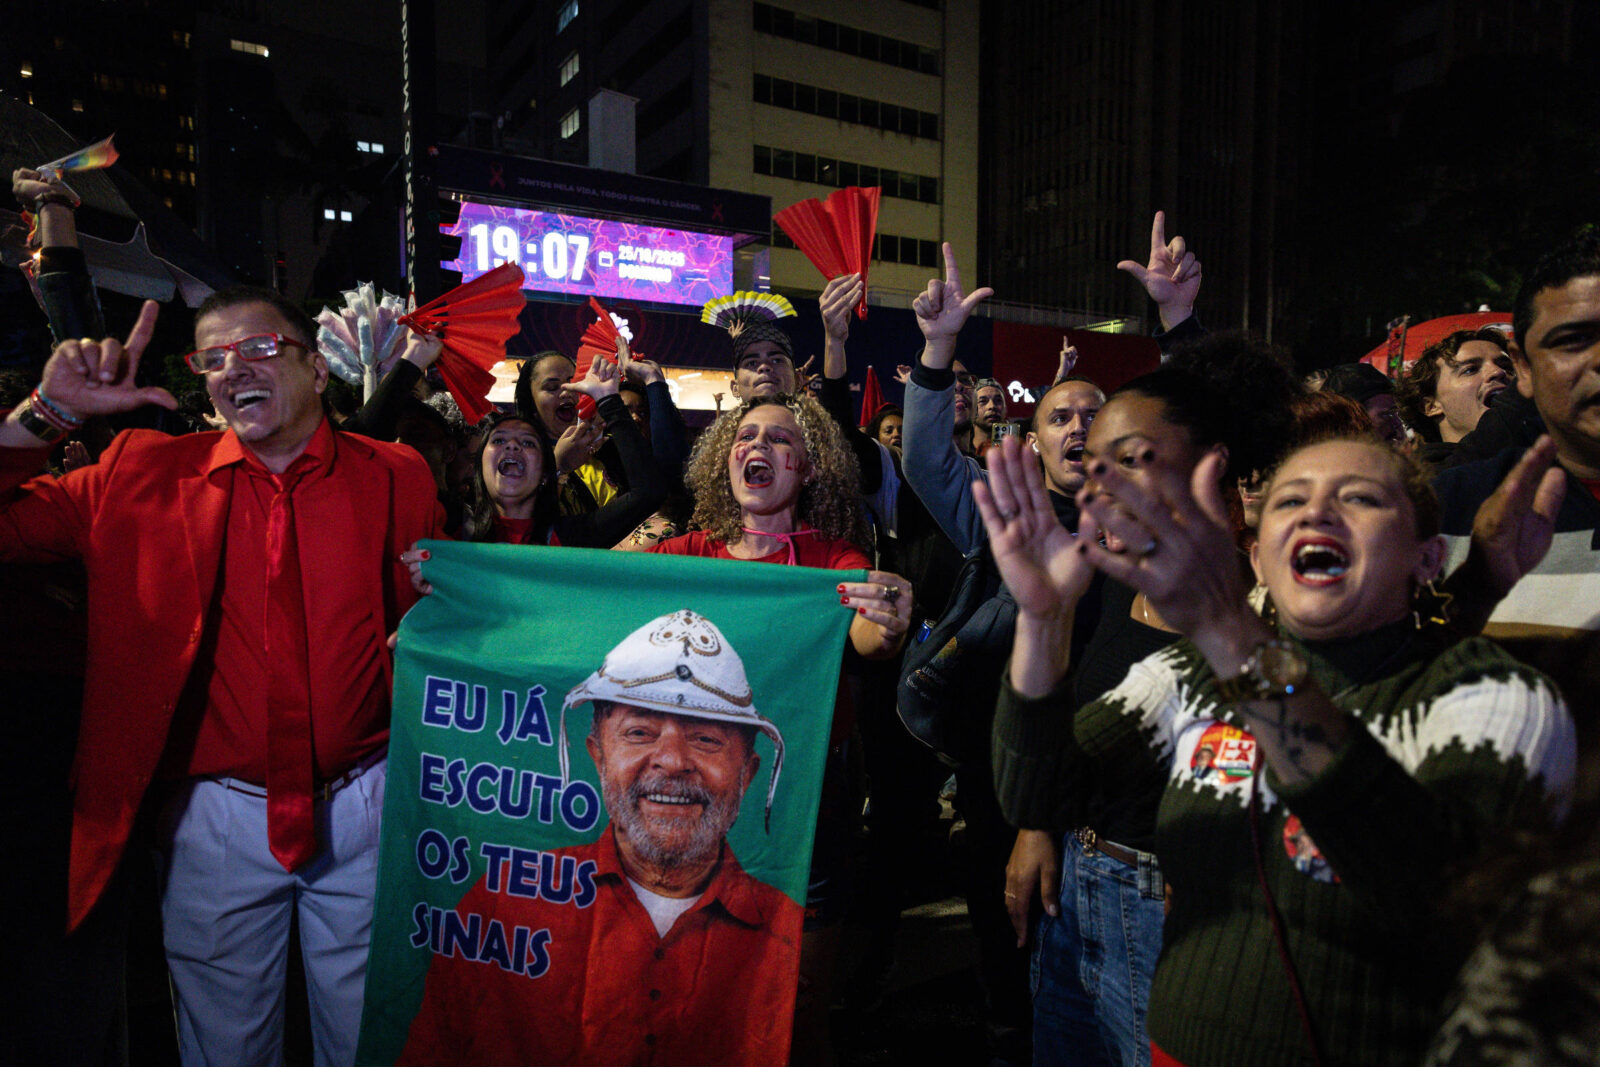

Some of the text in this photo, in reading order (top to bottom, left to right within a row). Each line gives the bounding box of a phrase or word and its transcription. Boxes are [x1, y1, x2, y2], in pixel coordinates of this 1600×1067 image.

[400, 0, 410, 113] Mende
[518, 177, 552, 189] JUNTOS
[553, 183, 575, 193] PELA
[600, 189, 628, 201] TODOS
[629, 195, 661, 206] CONTRA
[470, 223, 590, 281] 19:07
[422, 675, 553, 747] EU JÁ
[420, 752, 601, 832] ESCUTO
[416, 829, 598, 910] OS TEUS
[410, 902, 552, 978] SINAIS
